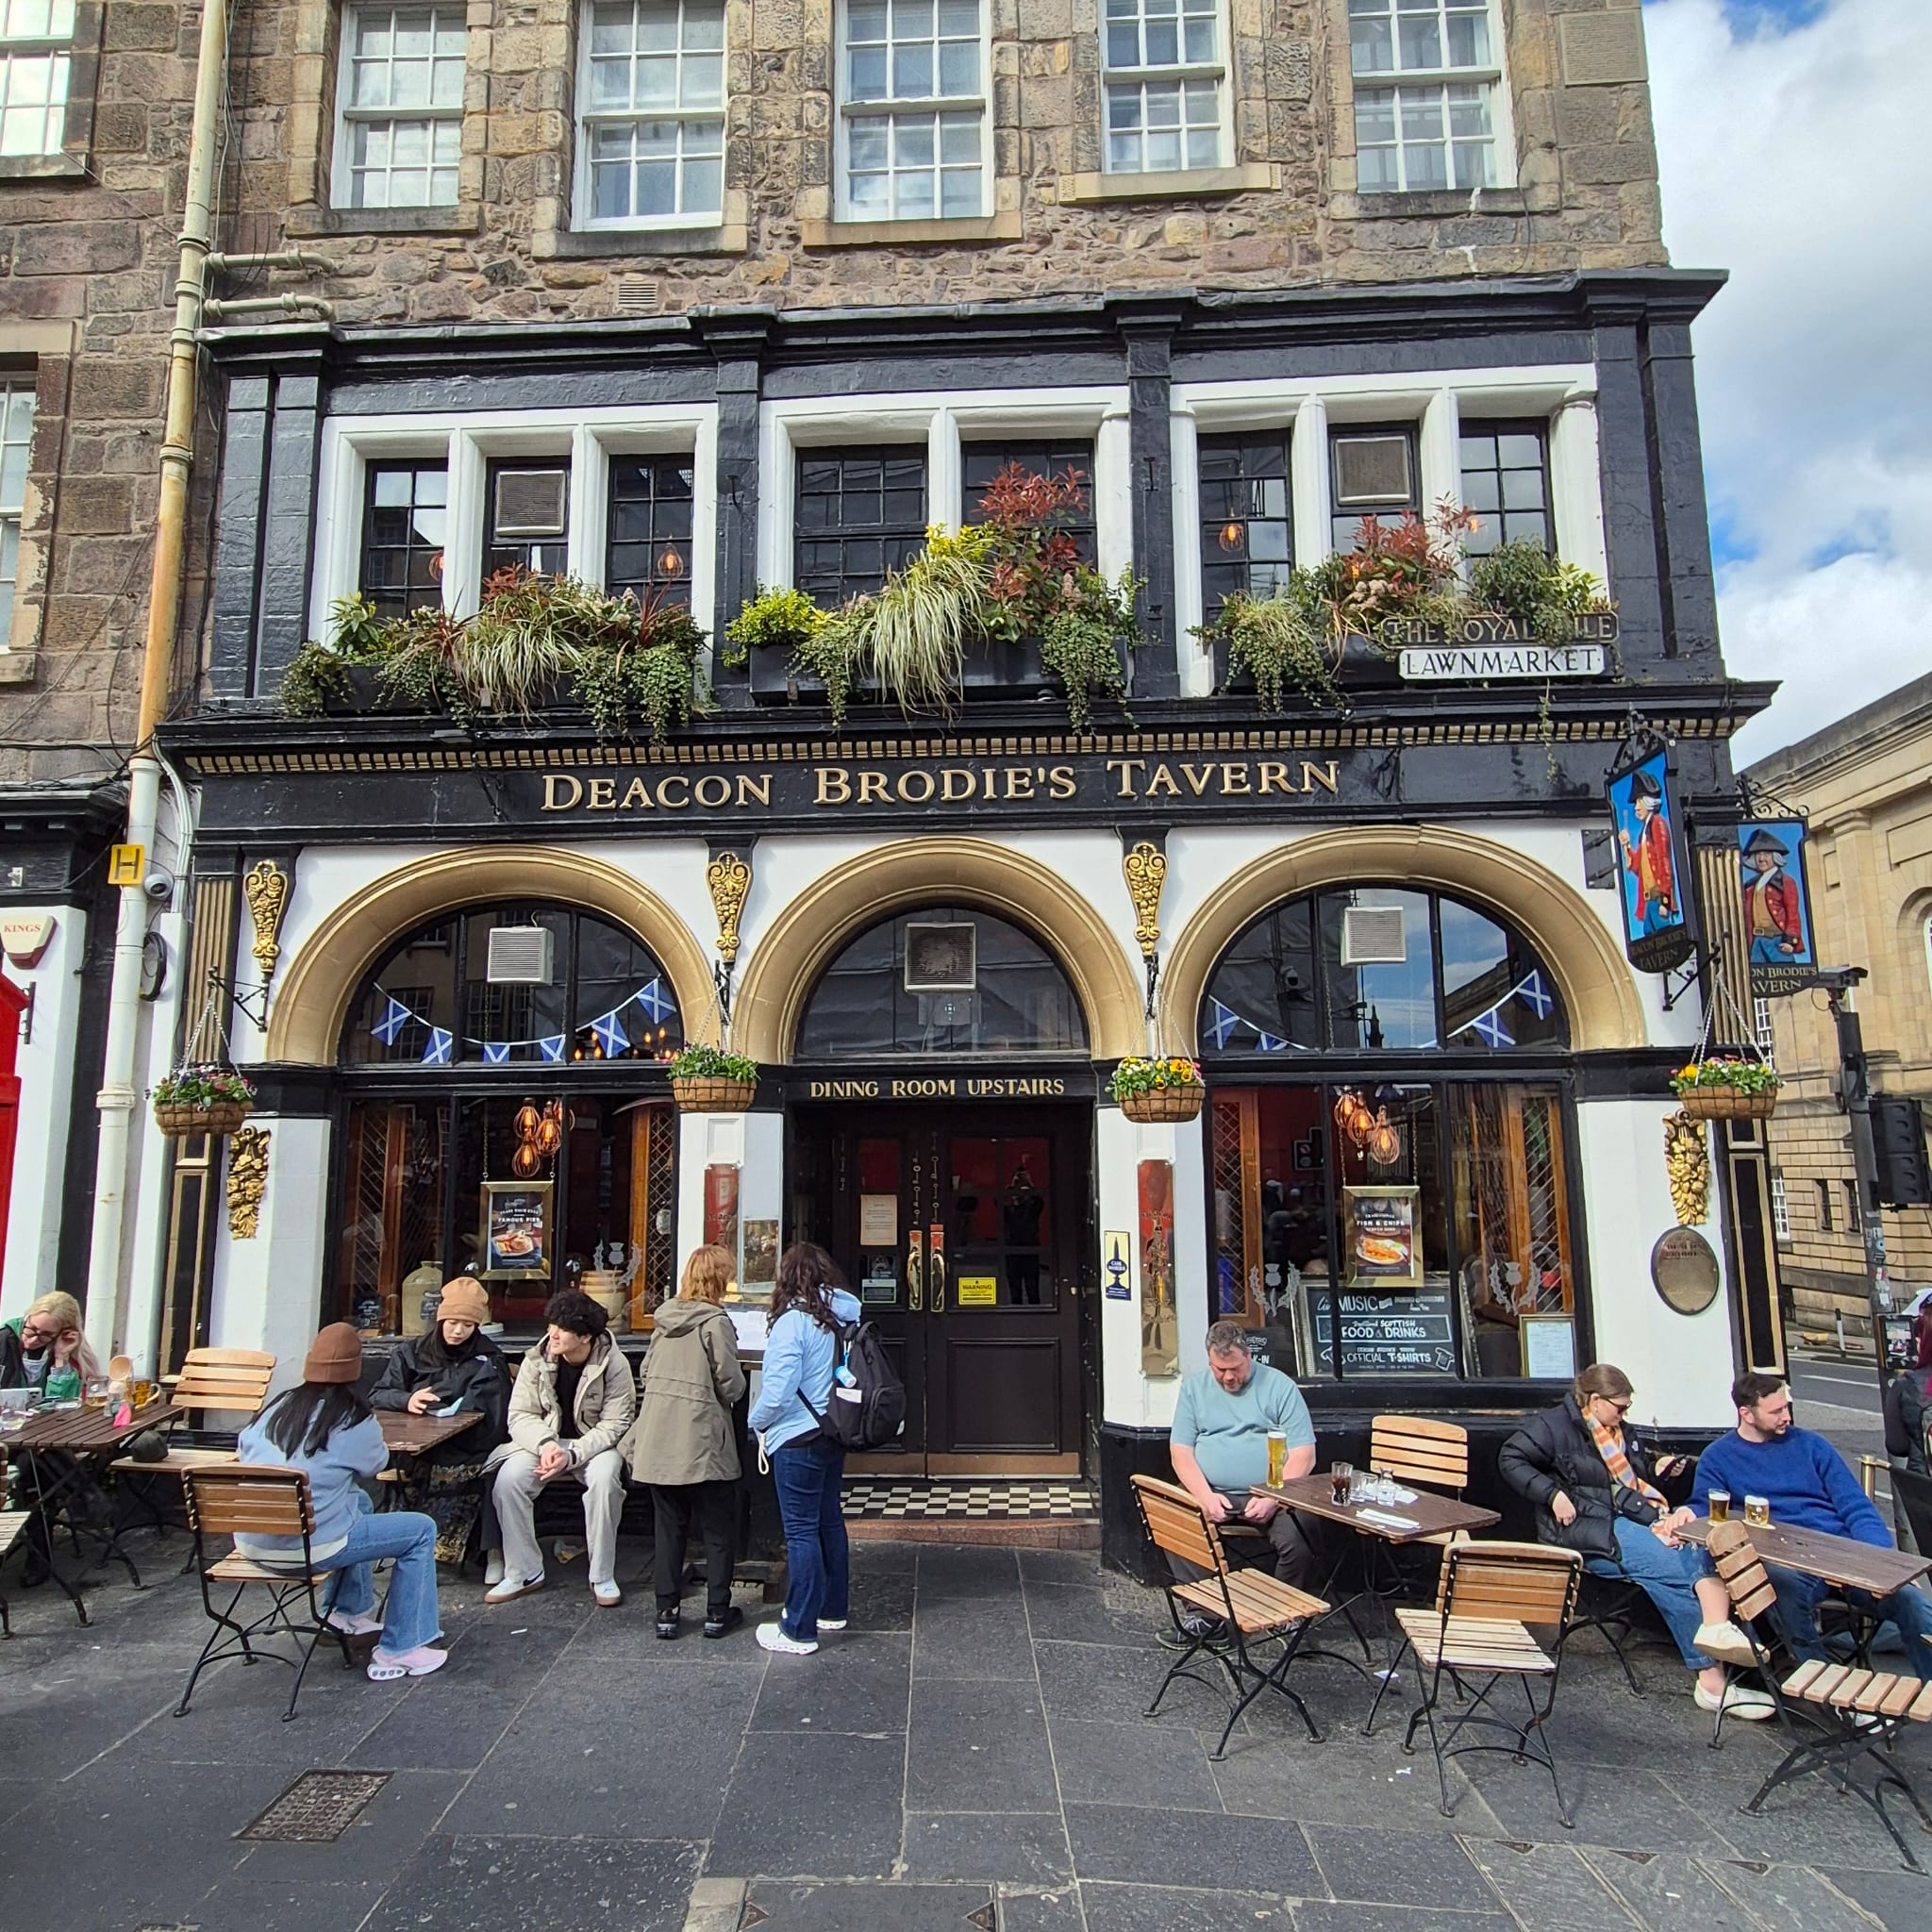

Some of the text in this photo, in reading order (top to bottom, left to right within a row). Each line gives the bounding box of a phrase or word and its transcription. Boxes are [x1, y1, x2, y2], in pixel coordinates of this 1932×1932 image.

[1448, 618, 1536, 643] OYAL
[1406, 648, 1597, 675] LAWNMARKET
[541, 759, 1339, 810] DEACON BRODIE'S TAVERN
[4, 924, 41, 933] KINGS
[810, 1078, 1065, 1097] DINING ROOM UPSTAIRS
[1341, 1327, 1374, 1338] FOOD
[1385, 1327, 1426, 1338] DRINKS
[1346, 1353, 1387, 1363] OFFICIAL
